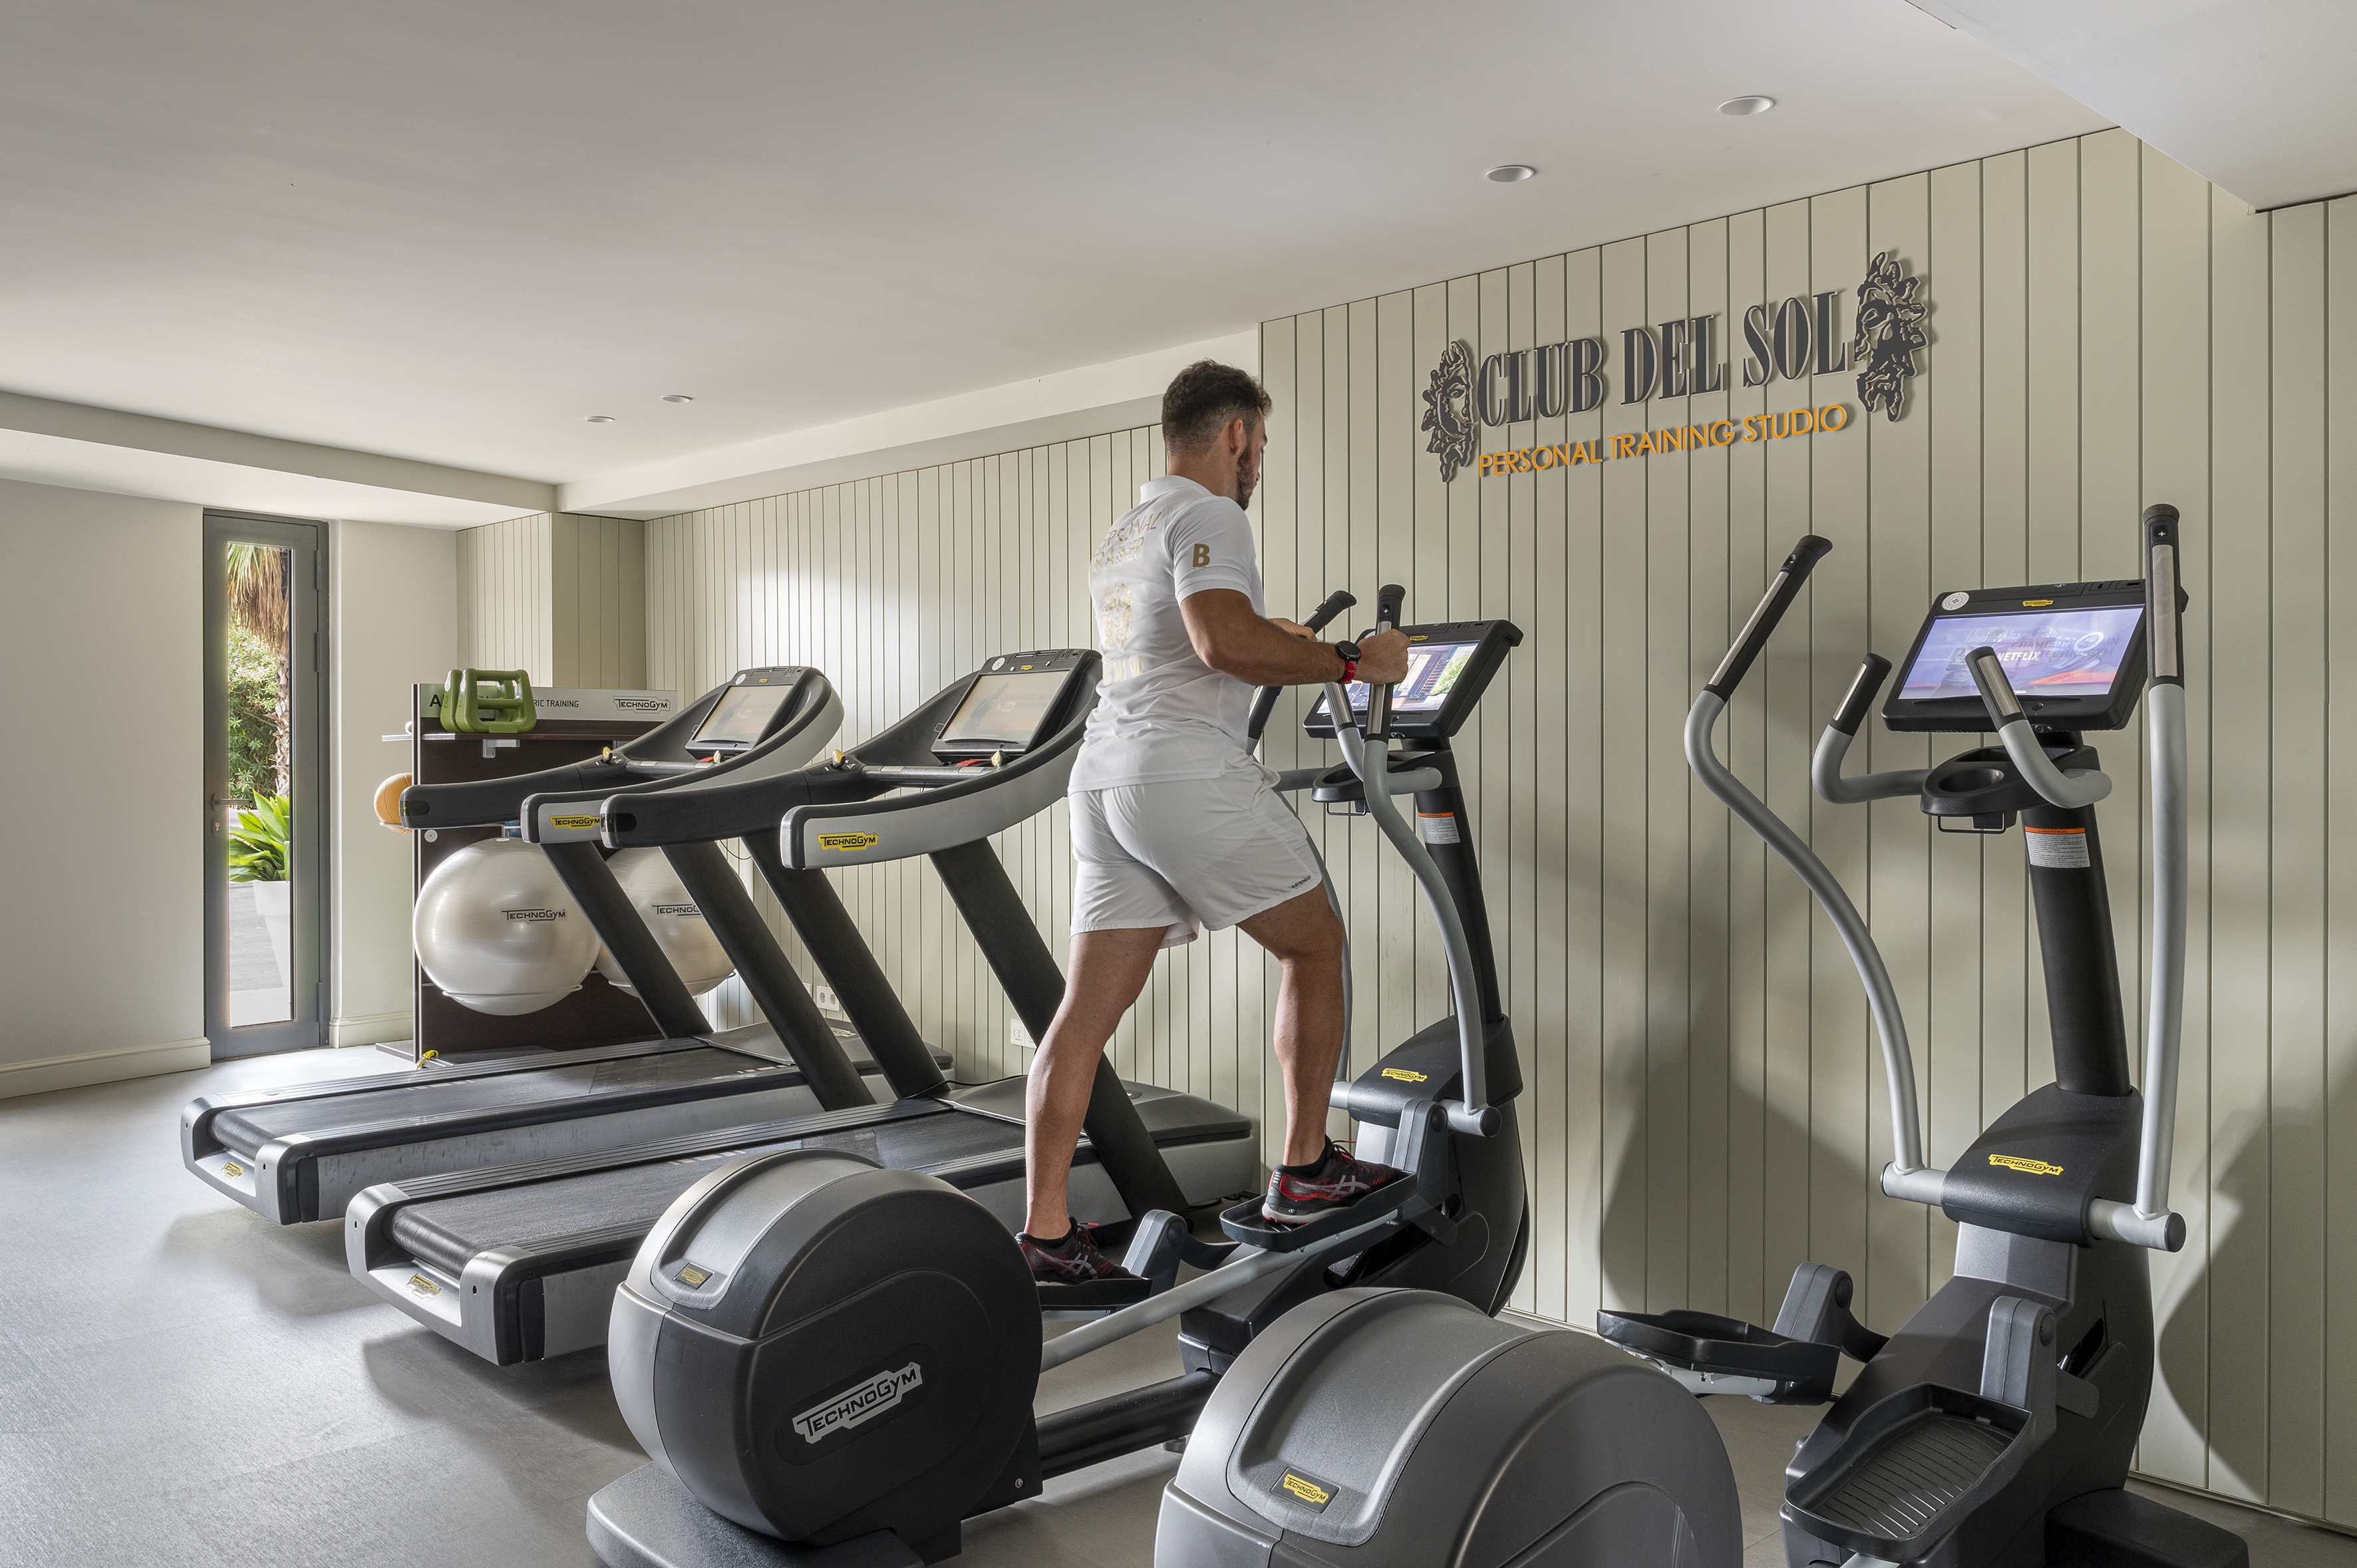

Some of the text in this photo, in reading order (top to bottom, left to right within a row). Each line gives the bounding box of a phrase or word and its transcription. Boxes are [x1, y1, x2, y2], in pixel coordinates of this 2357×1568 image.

[1477, 291, 1849, 427] CLUB DEL SOL
[1479, 404, 1847, 477] PERSONAL TRAINING STUDIO
[1192, 544, 1210, 567] B
[1998, 651, 2041, 662] NETFLIX
[546, 699, 579, 708] TRAINING
[615, 699, 668, 710] TECHNOGYM
[820, 835, 875, 848] TECHNOGYM
[502, 909, 566, 921] TECHNOGYM
[652, 904, 701, 916] TECHNOG
[1384, 1069, 1424, 1080] TECHNOGYM
[1992, 1156, 2059, 1173] TECHNOGYM
[796, 1368, 917, 1437] TECHNOGYM
[1286, 1476, 1326, 1501] TECHNOGYM
